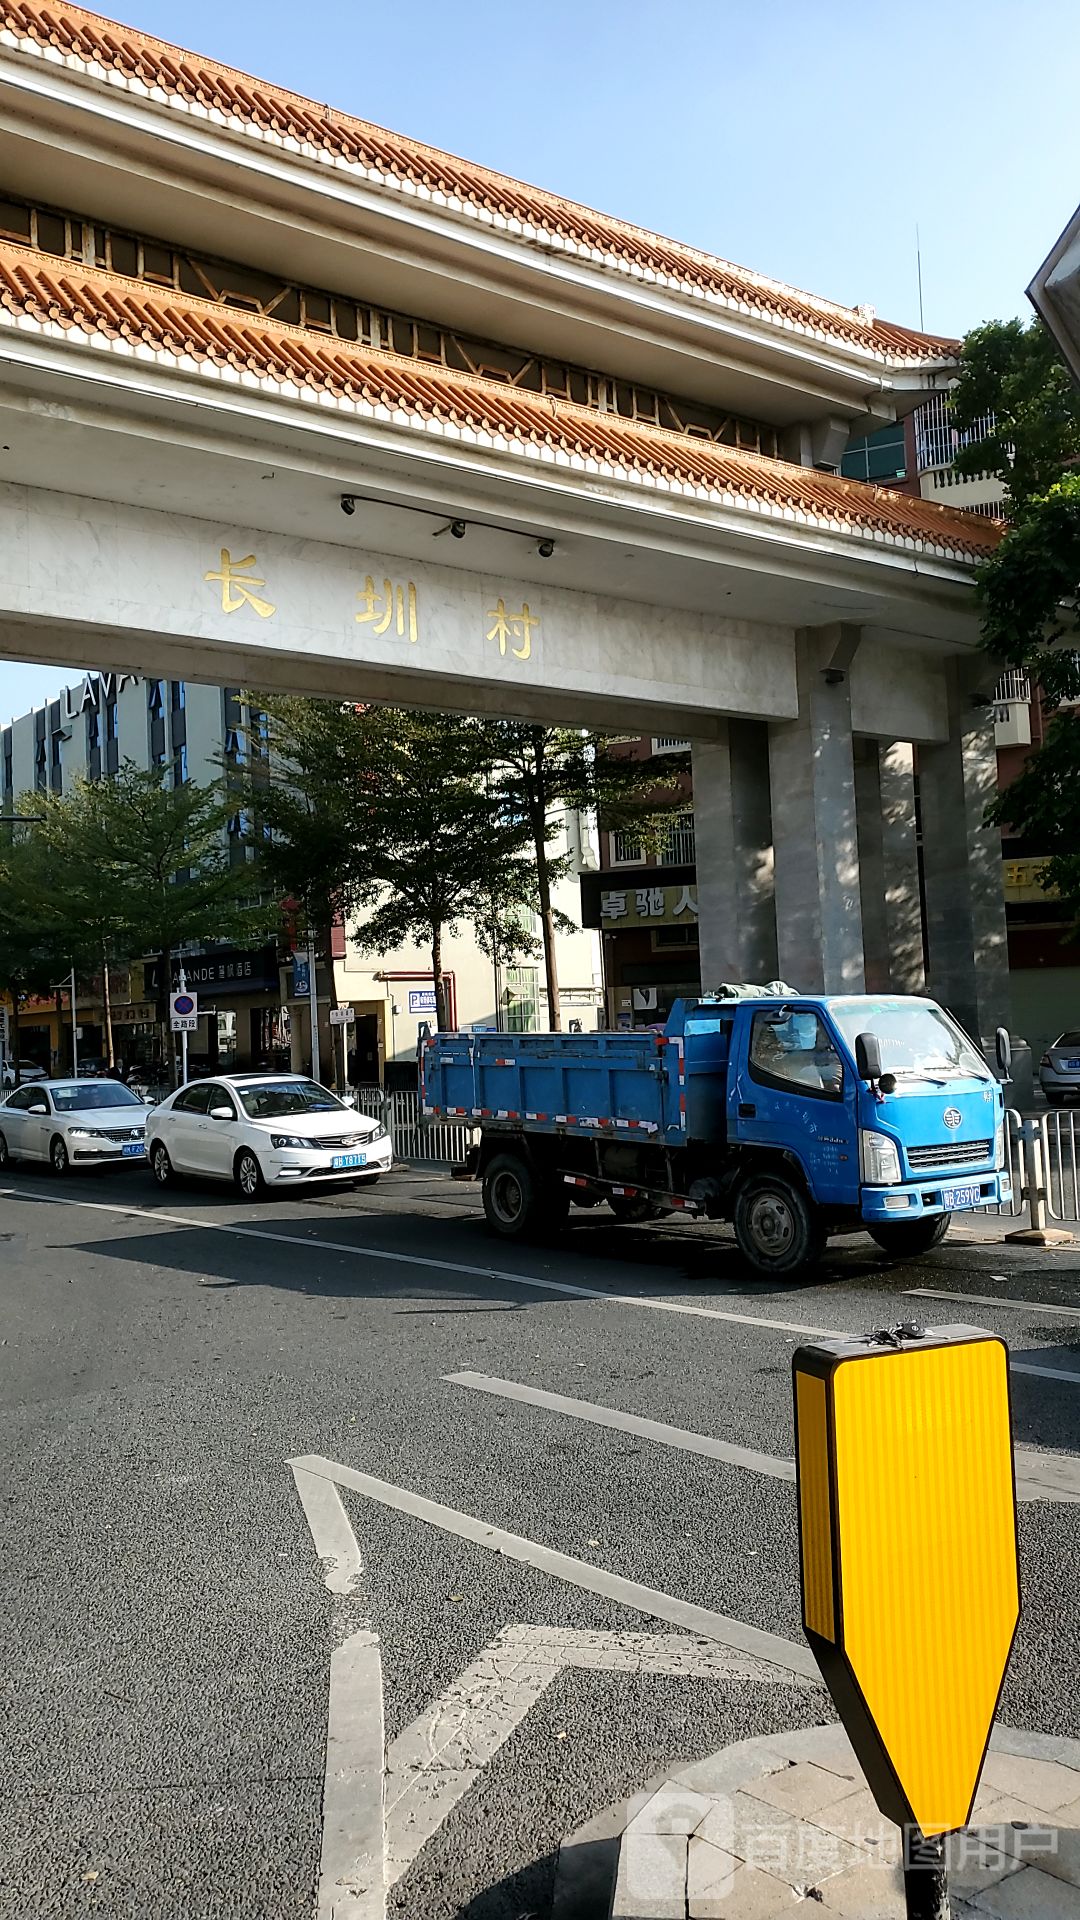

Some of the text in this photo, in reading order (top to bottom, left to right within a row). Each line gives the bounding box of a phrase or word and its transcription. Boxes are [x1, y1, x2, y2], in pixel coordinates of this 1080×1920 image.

[204, 547, 541, 660] 长圳村
[600, 886, 699, 919] 卓驰人
[173, 1019, 196, 1029] 全路段
